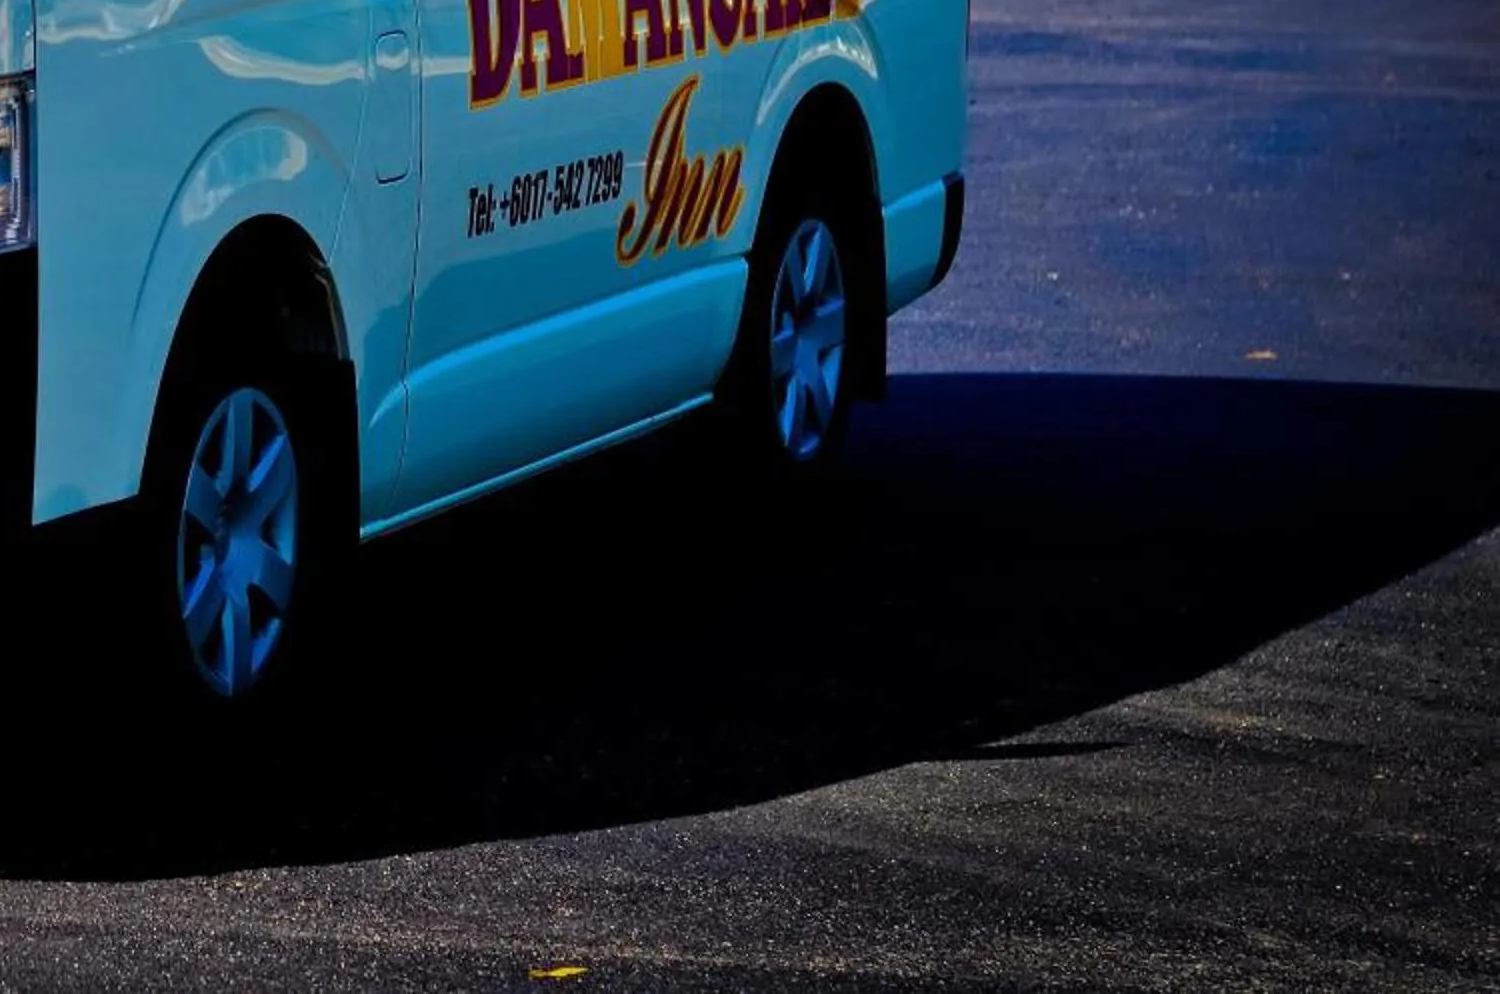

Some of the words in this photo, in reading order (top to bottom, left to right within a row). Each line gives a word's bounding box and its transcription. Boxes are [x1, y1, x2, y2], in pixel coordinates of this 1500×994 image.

[467, 183, 497, 238] Tel:
[585, 150, 624, 205] 7299
[616, 73, 745, 267] Inn
